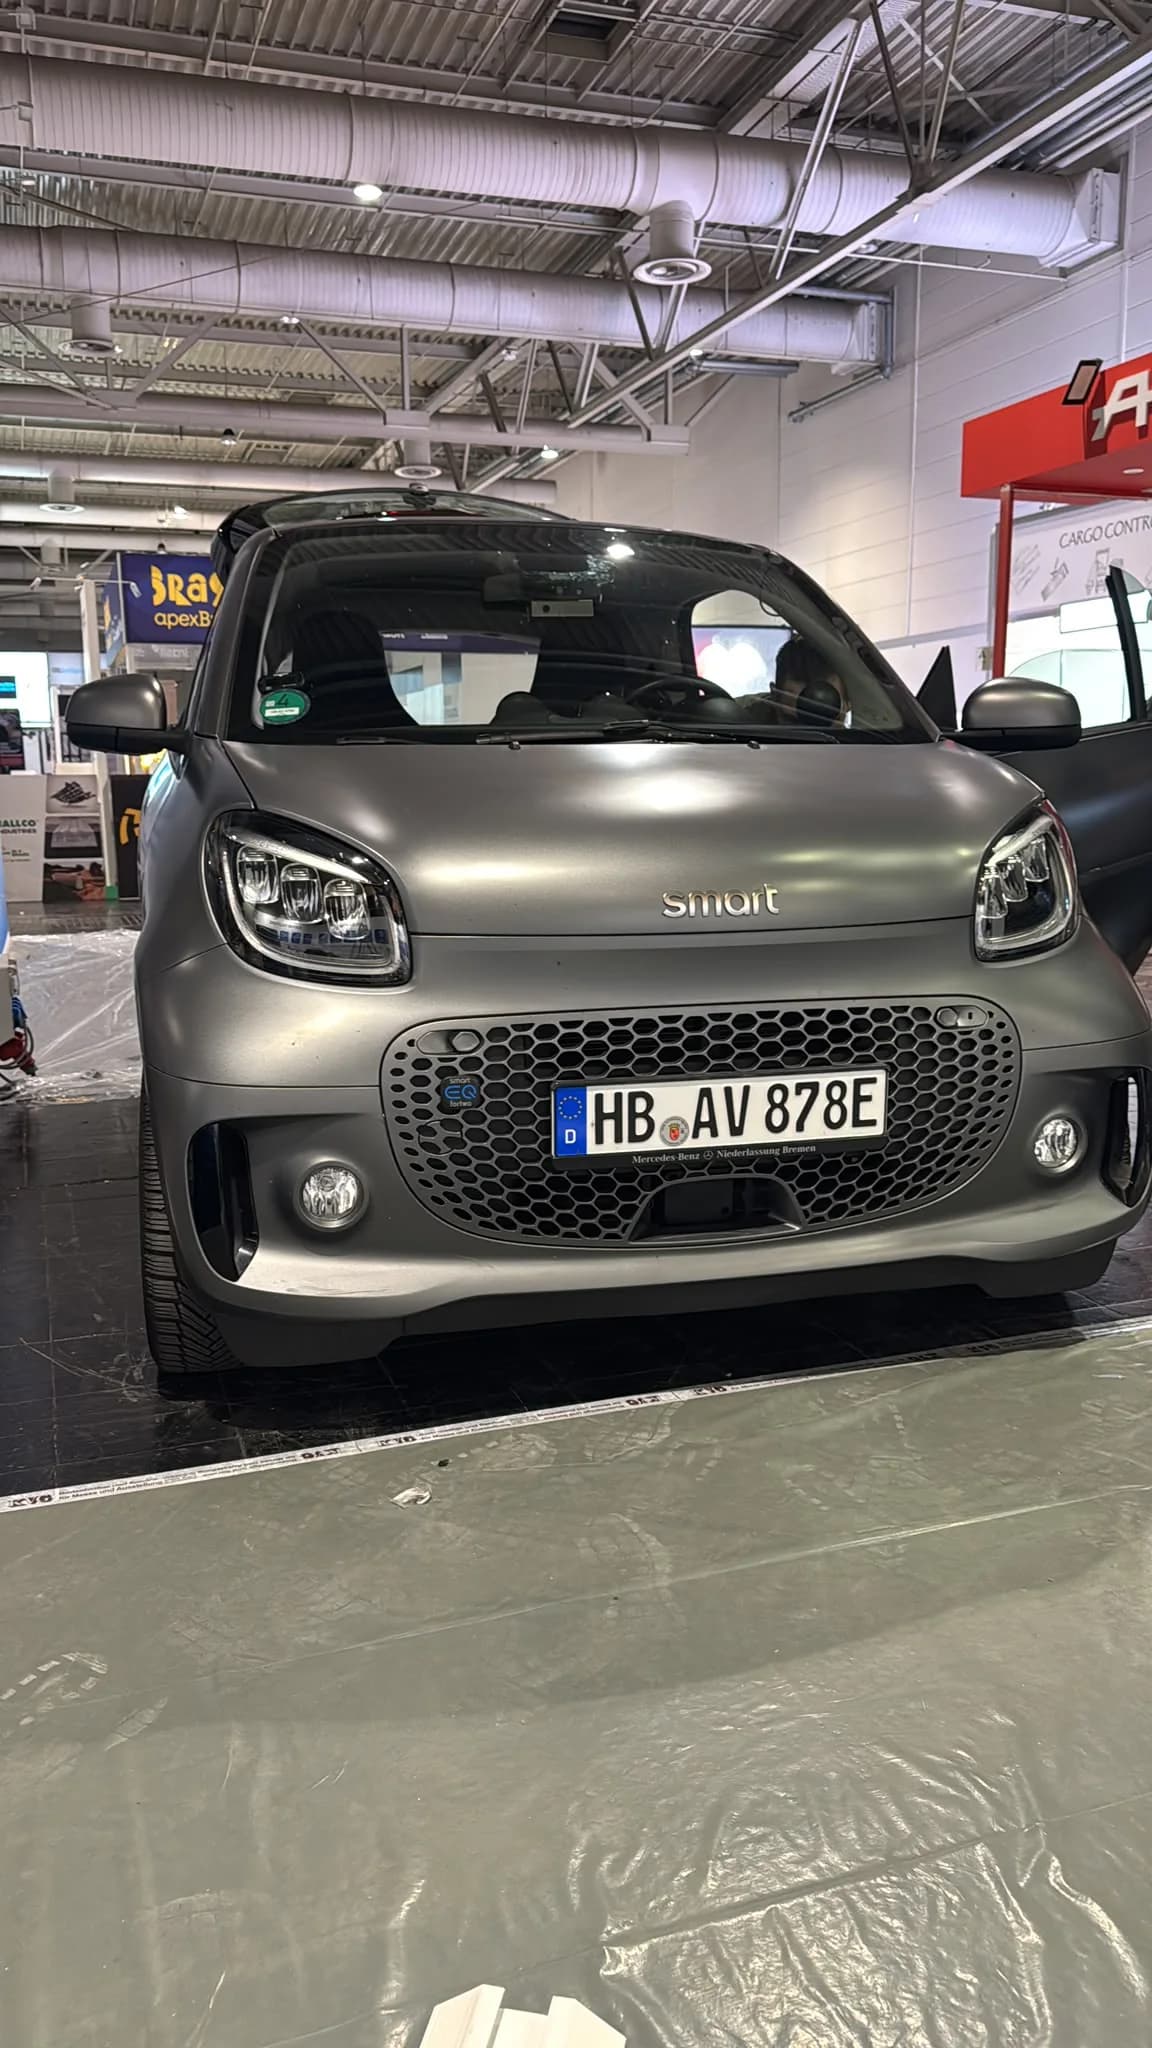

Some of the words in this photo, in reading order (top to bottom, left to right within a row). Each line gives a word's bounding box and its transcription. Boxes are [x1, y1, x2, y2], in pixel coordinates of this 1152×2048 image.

[1058, 525, 1103, 549] CARGO
[1104, 514, 1152, 539] CONTR
[154, 610, 213, 630] apexB
[0, 819, 36, 828] ALLCO
[662, 883, 780, 918] smart
[444, 1085, 477, 1099] EQ
[594, 1090, 656, 1145] HB
[691, 1085, 751, 1139] AV
[765, 1077, 878, 1134] 878E
[564, 1128, 577, 1144] D
[632, 1151, 700, 1164] Mercedes-Benz
[716, 1146, 780, 1159] Niederlassung
[782, 1144, 816, 1154] Bremen
